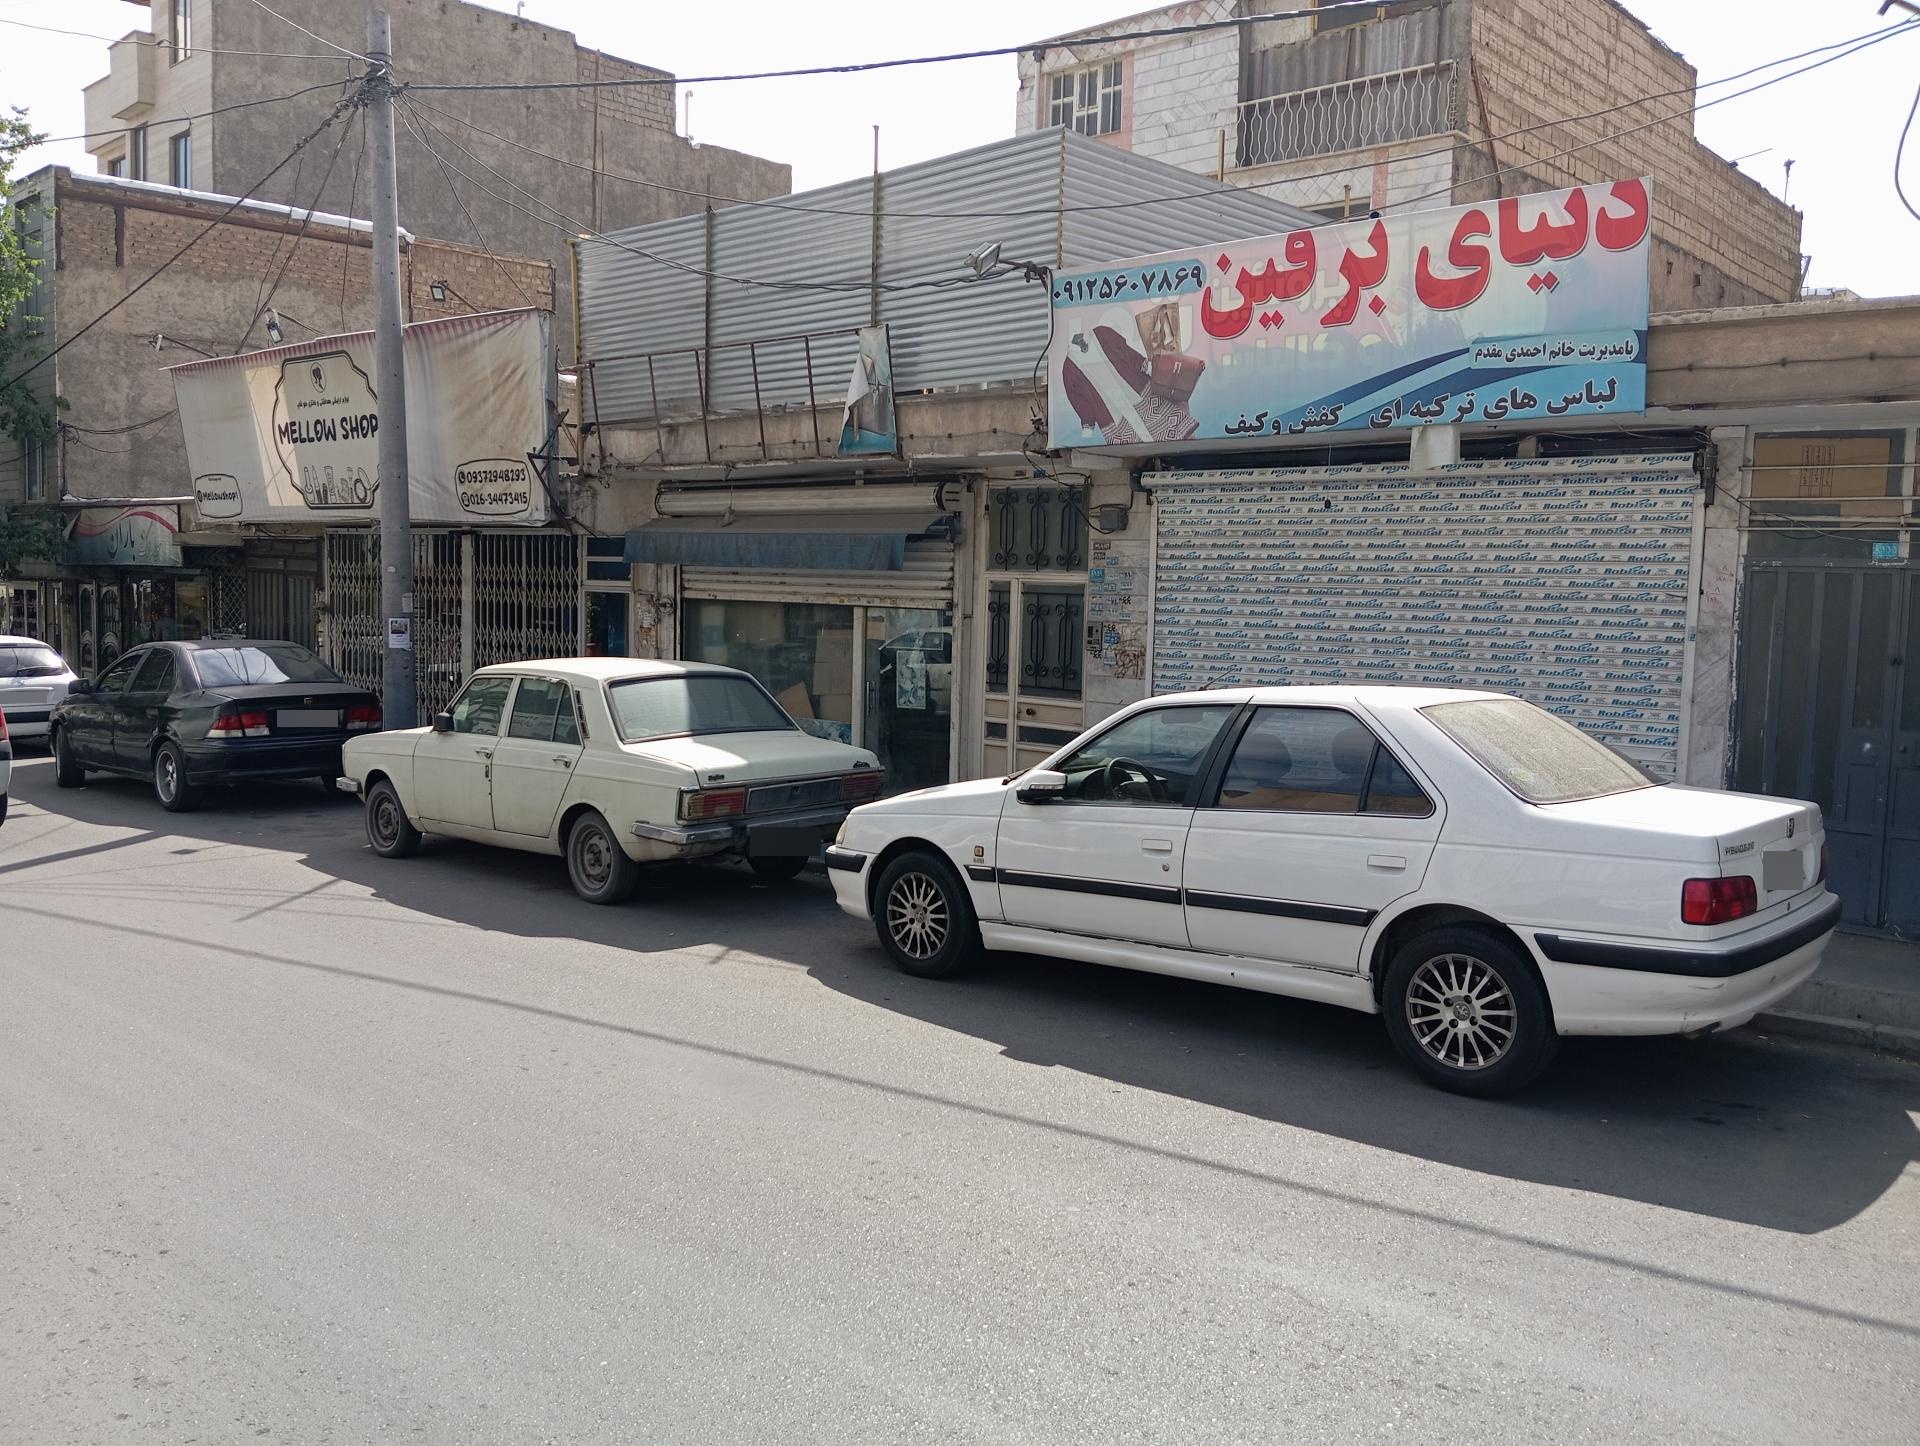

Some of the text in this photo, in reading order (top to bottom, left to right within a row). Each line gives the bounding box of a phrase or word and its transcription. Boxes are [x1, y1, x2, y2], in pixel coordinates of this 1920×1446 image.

[1053, 265, 1203, 302] ۰۹۱۲۵۶۰۷۸۶۹
[1474, 345, 1502, 363] مقدم
[1505, 342, 1547, 363] احمدی
[1549, 340, 1575, 361] خانم
[1409, 391, 1476, 424] ترکیه
[1482, 386, 1538, 420] های
[1546, 377, 1618, 415] لباس
[1288, 403, 1345, 434] کفش
[1369, 397, 1402, 428] ای
[278, 413, 378, 444] MELLOW SHOP
[466, 468, 526, 483] 09372948293
[470, 492, 528, 505] 026-34473415
